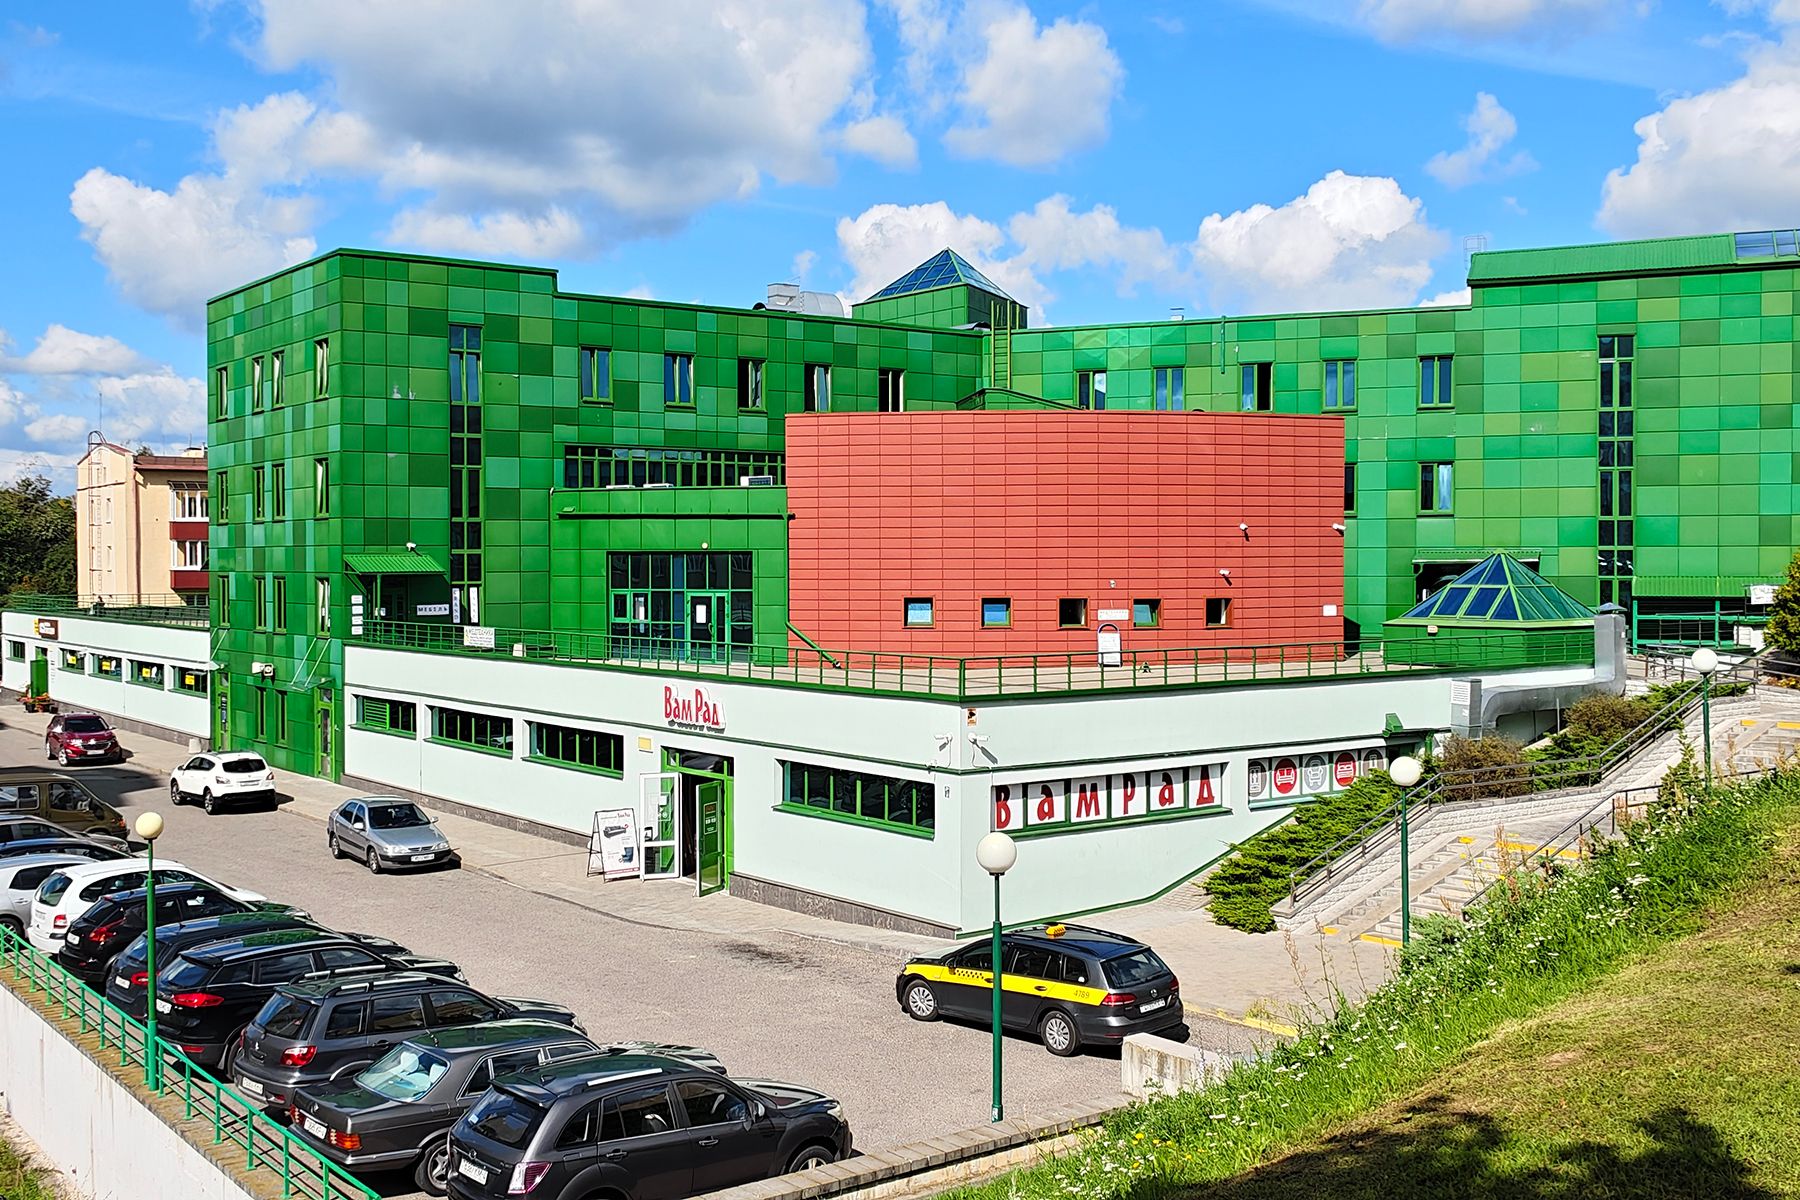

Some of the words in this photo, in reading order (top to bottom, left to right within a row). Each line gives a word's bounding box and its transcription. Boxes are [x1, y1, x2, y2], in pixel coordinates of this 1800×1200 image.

[664, 686, 693, 721] Вам
[695, 688, 720, 726] Рад
[1074, 990, 1090, 999] 4789
